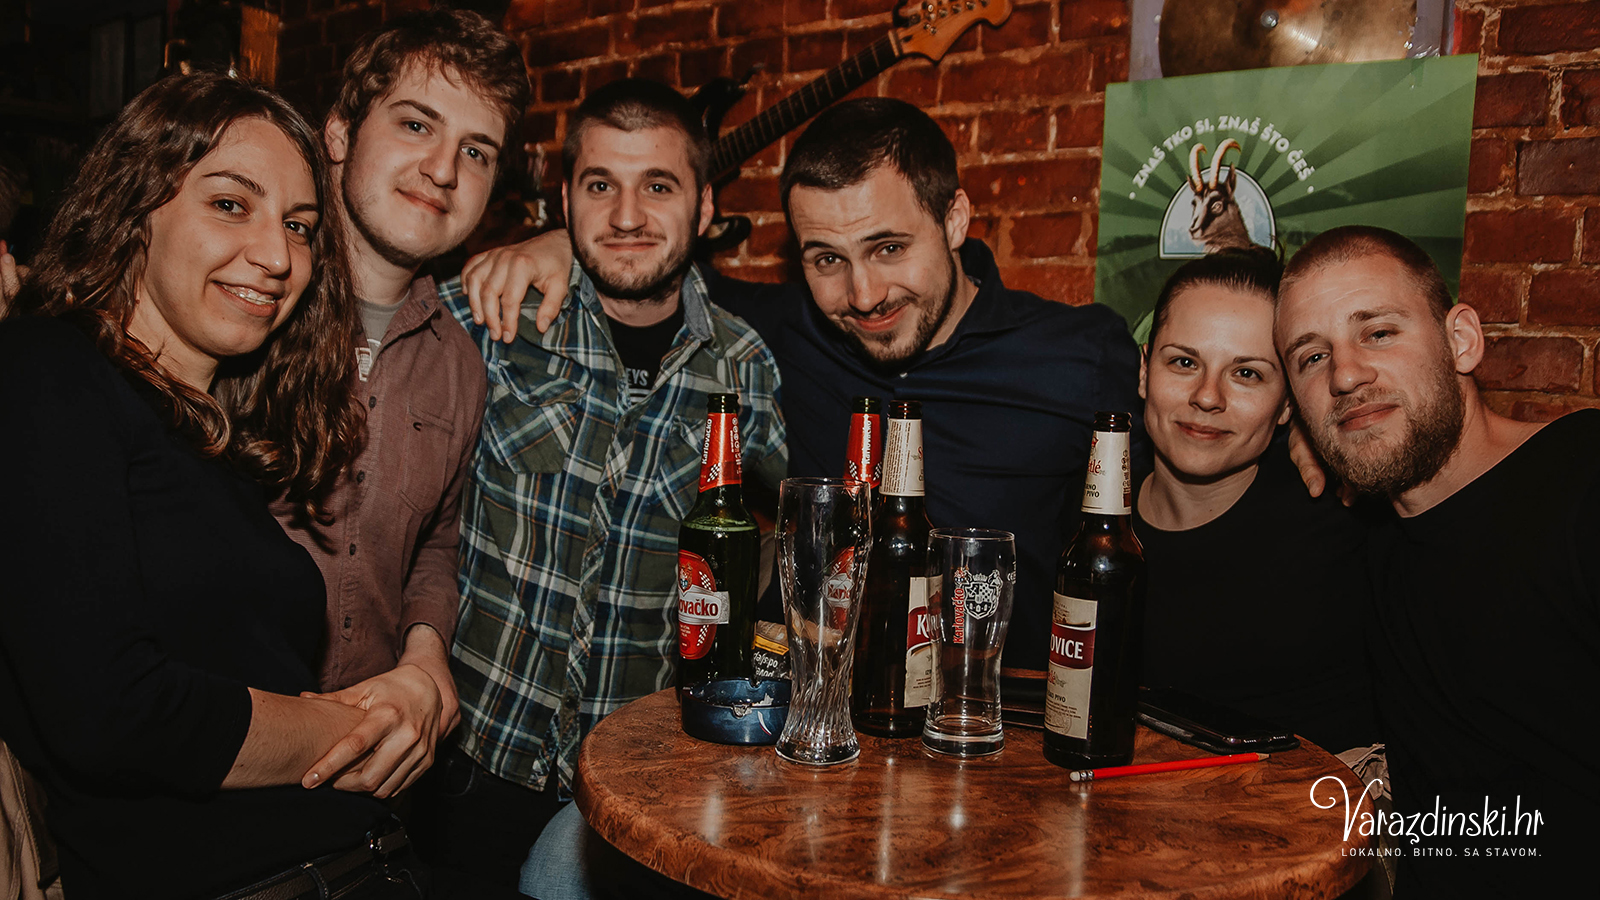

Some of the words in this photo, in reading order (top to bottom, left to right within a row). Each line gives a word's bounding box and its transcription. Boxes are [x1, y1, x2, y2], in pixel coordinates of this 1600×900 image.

[1132, 145, 1166, 189] ZNAŠ
[1162, 125, 1193, 151] TKO
[1195, 118, 1215, 135] SI,
[1217, 115, 1261, 136] ZNAŠ
[1260, 123, 1290, 153] ŠTO
